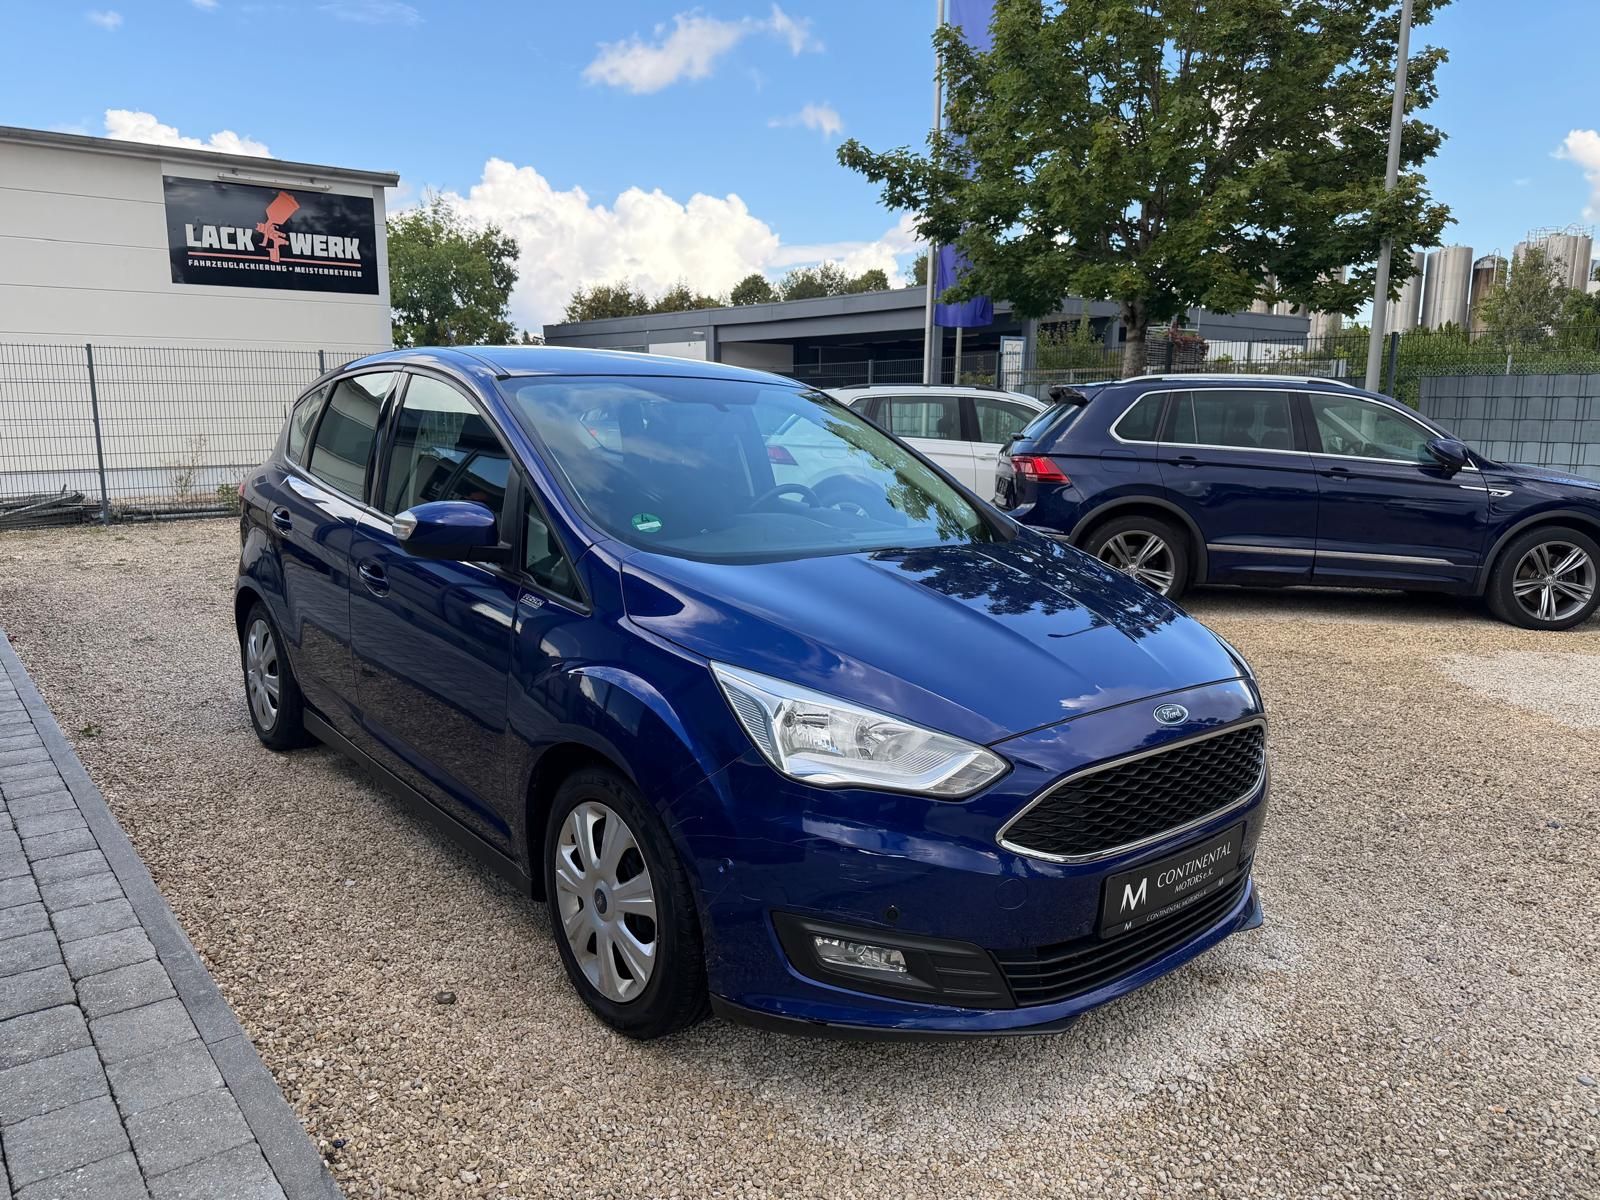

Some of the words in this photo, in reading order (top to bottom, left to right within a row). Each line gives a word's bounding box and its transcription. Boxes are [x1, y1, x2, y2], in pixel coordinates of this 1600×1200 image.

[185, 223, 255, 251] LACK
[288, 232, 361, 260] WERK
[188, 259, 287, 272] FAHRZEUGLACKIERUNG
[294, 266, 362, 278] MEISTERBETRIEB
[1161, 707, 1182, 720] Ford
[1157, 841, 1232, 888] CONTINENTAL
[1174, 871, 1202, 894] MOTORS
[1120, 877, 1148, 914] M
[1146, 902, 1182, 922] CONTINENTAL
